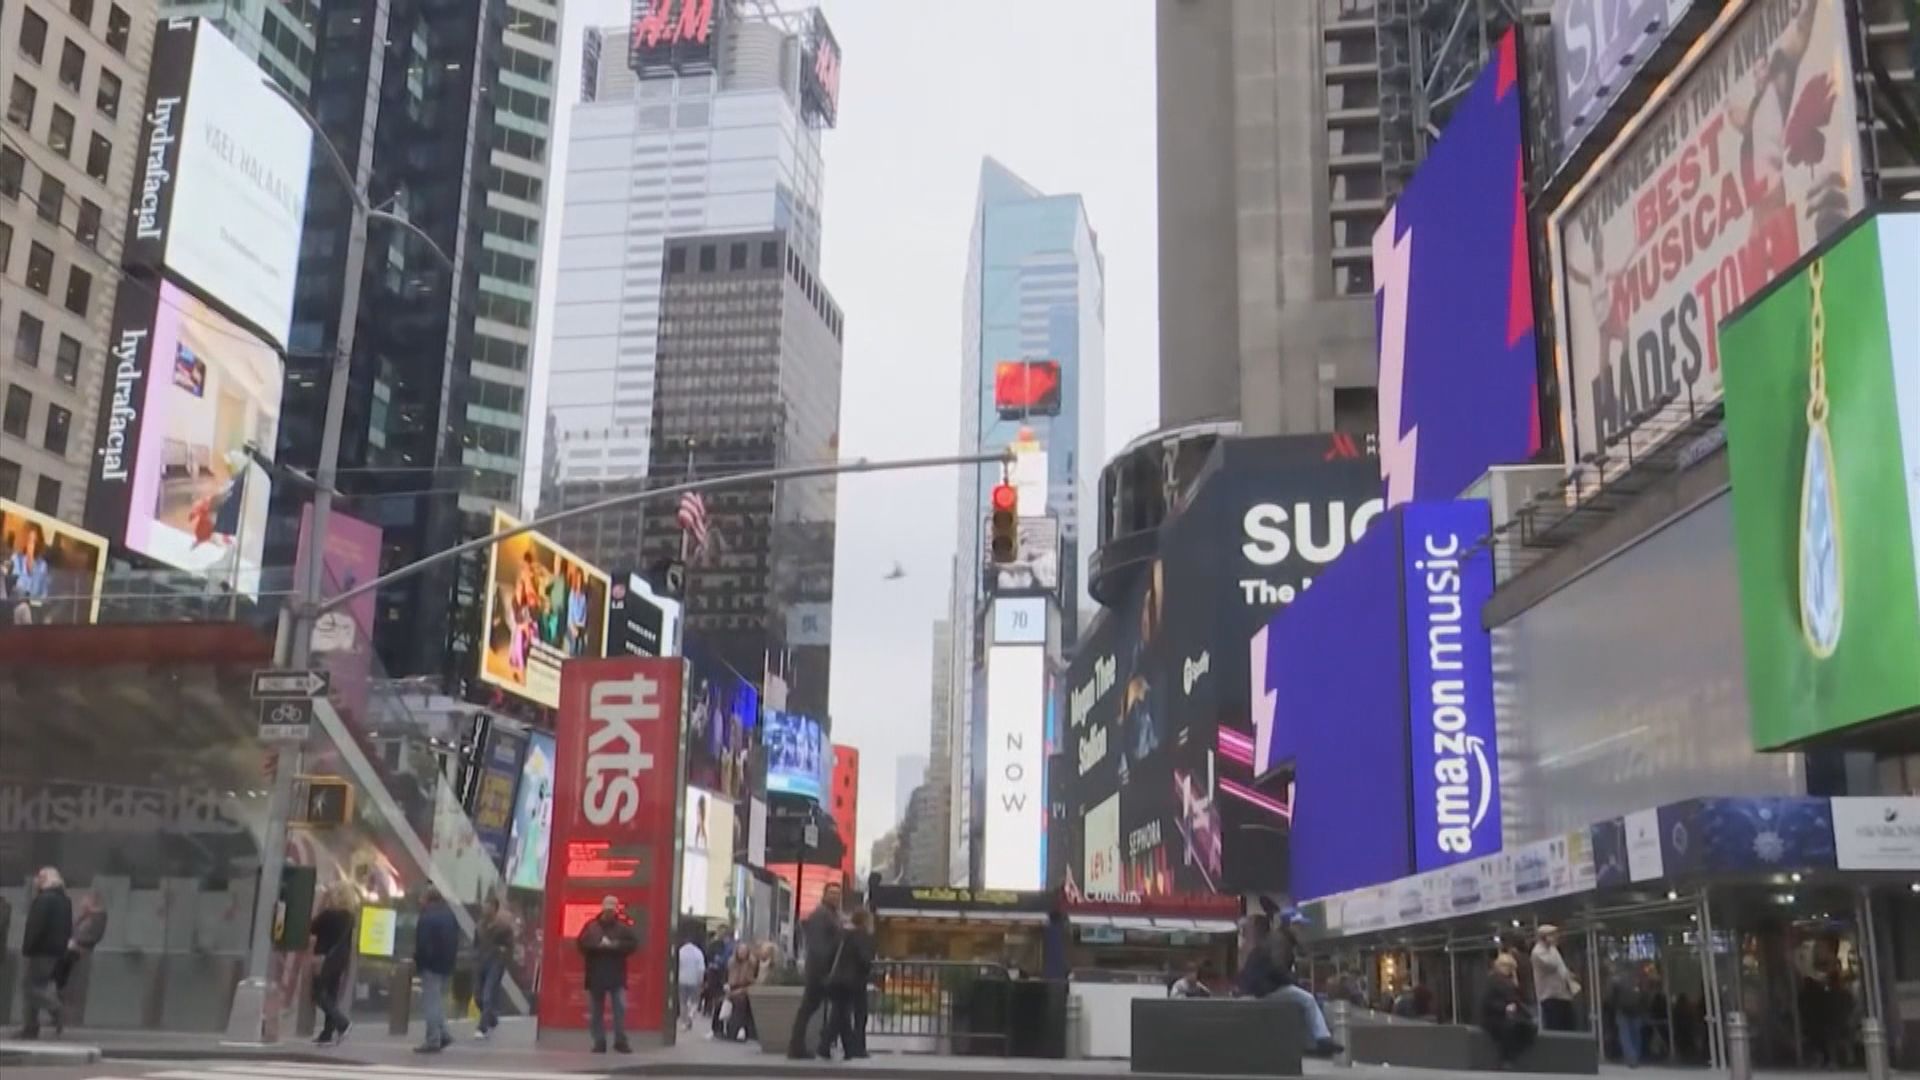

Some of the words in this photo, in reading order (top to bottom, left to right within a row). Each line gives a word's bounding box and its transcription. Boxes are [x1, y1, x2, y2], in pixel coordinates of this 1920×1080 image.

[137, 96, 181, 240] hydrafacial
[1610, 150, 1769, 330] MUSICAL
[1635, 112, 1725, 246] BEST
[99, 328, 148, 482] hydrafacial
[1011, 611, 1028, 629] 70
[1239, 579, 1296, 605] The
[1415, 533, 1464, 670] music
[583, 672, 661, 826] tkts
[1432, 680, 1472, 854] amazon
